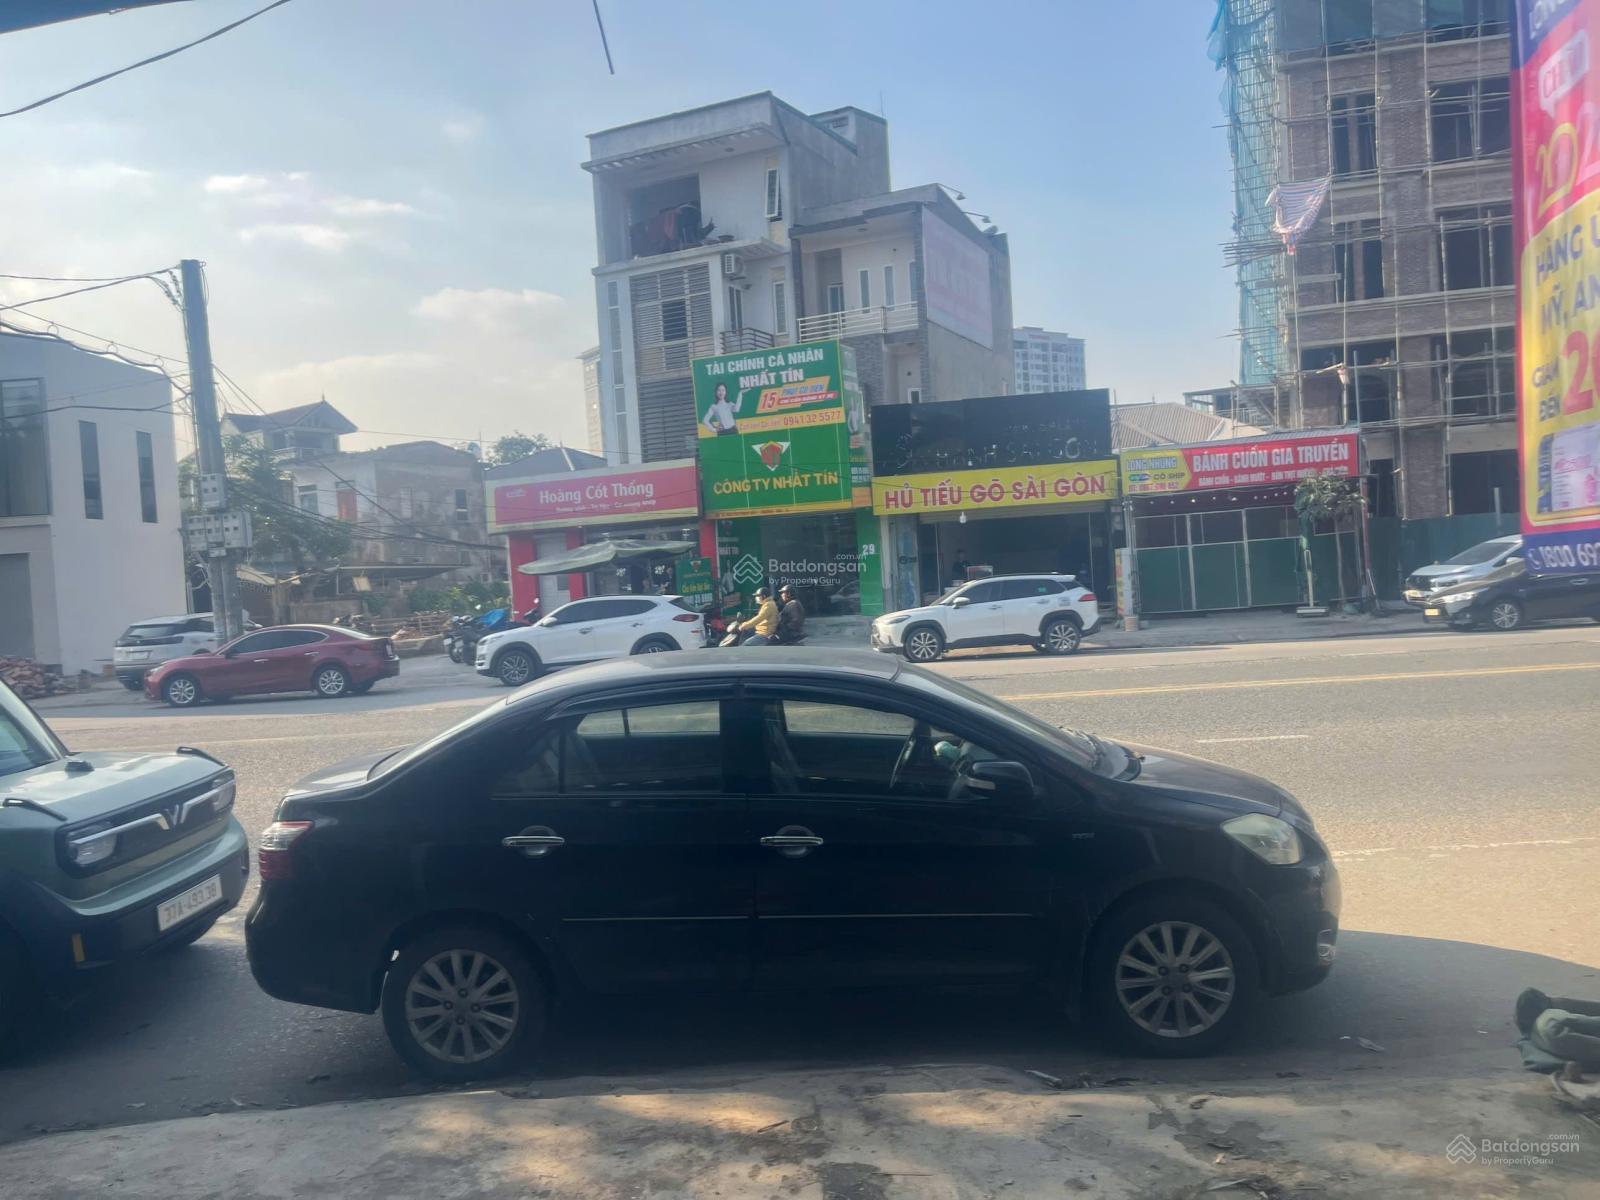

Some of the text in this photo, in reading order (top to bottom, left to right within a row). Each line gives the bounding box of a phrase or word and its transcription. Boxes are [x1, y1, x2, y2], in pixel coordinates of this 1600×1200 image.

[705, 361, 725, 376] TÀI
[727, 355, 765, 373] CHÍNH
[788, 347, 824, 365] NHÂN
[1562, 330, 1600, 416] 2
[739, 367, 805, 389] NHẤT TÍN
[761, 391, 778, 409] 15
[1193, 439, 1349, 472] BÁNH CUỐN GIA TRUYỀN
[539, 488, 582, 505] Hoàng
[586, 482, 609, 499] Cốt
[611, 479, 654, 498] Thống
[713, 478, 751, 495] CÔNG
[752, 477, 770, 491] TY
[773, 467, 811, 489] NHẤT
[813, 469, 839, 486] TÍN
[885, 481, 913, 509] HỦ
[920, 478, 962, 507] TIẾU
[1012, 475, 1046, 501] SÀI
[1054, 472, 1105, 497] GÒN
[863, 544, 875, 555] 29
[1539, 545, 1577, 569] 1800
